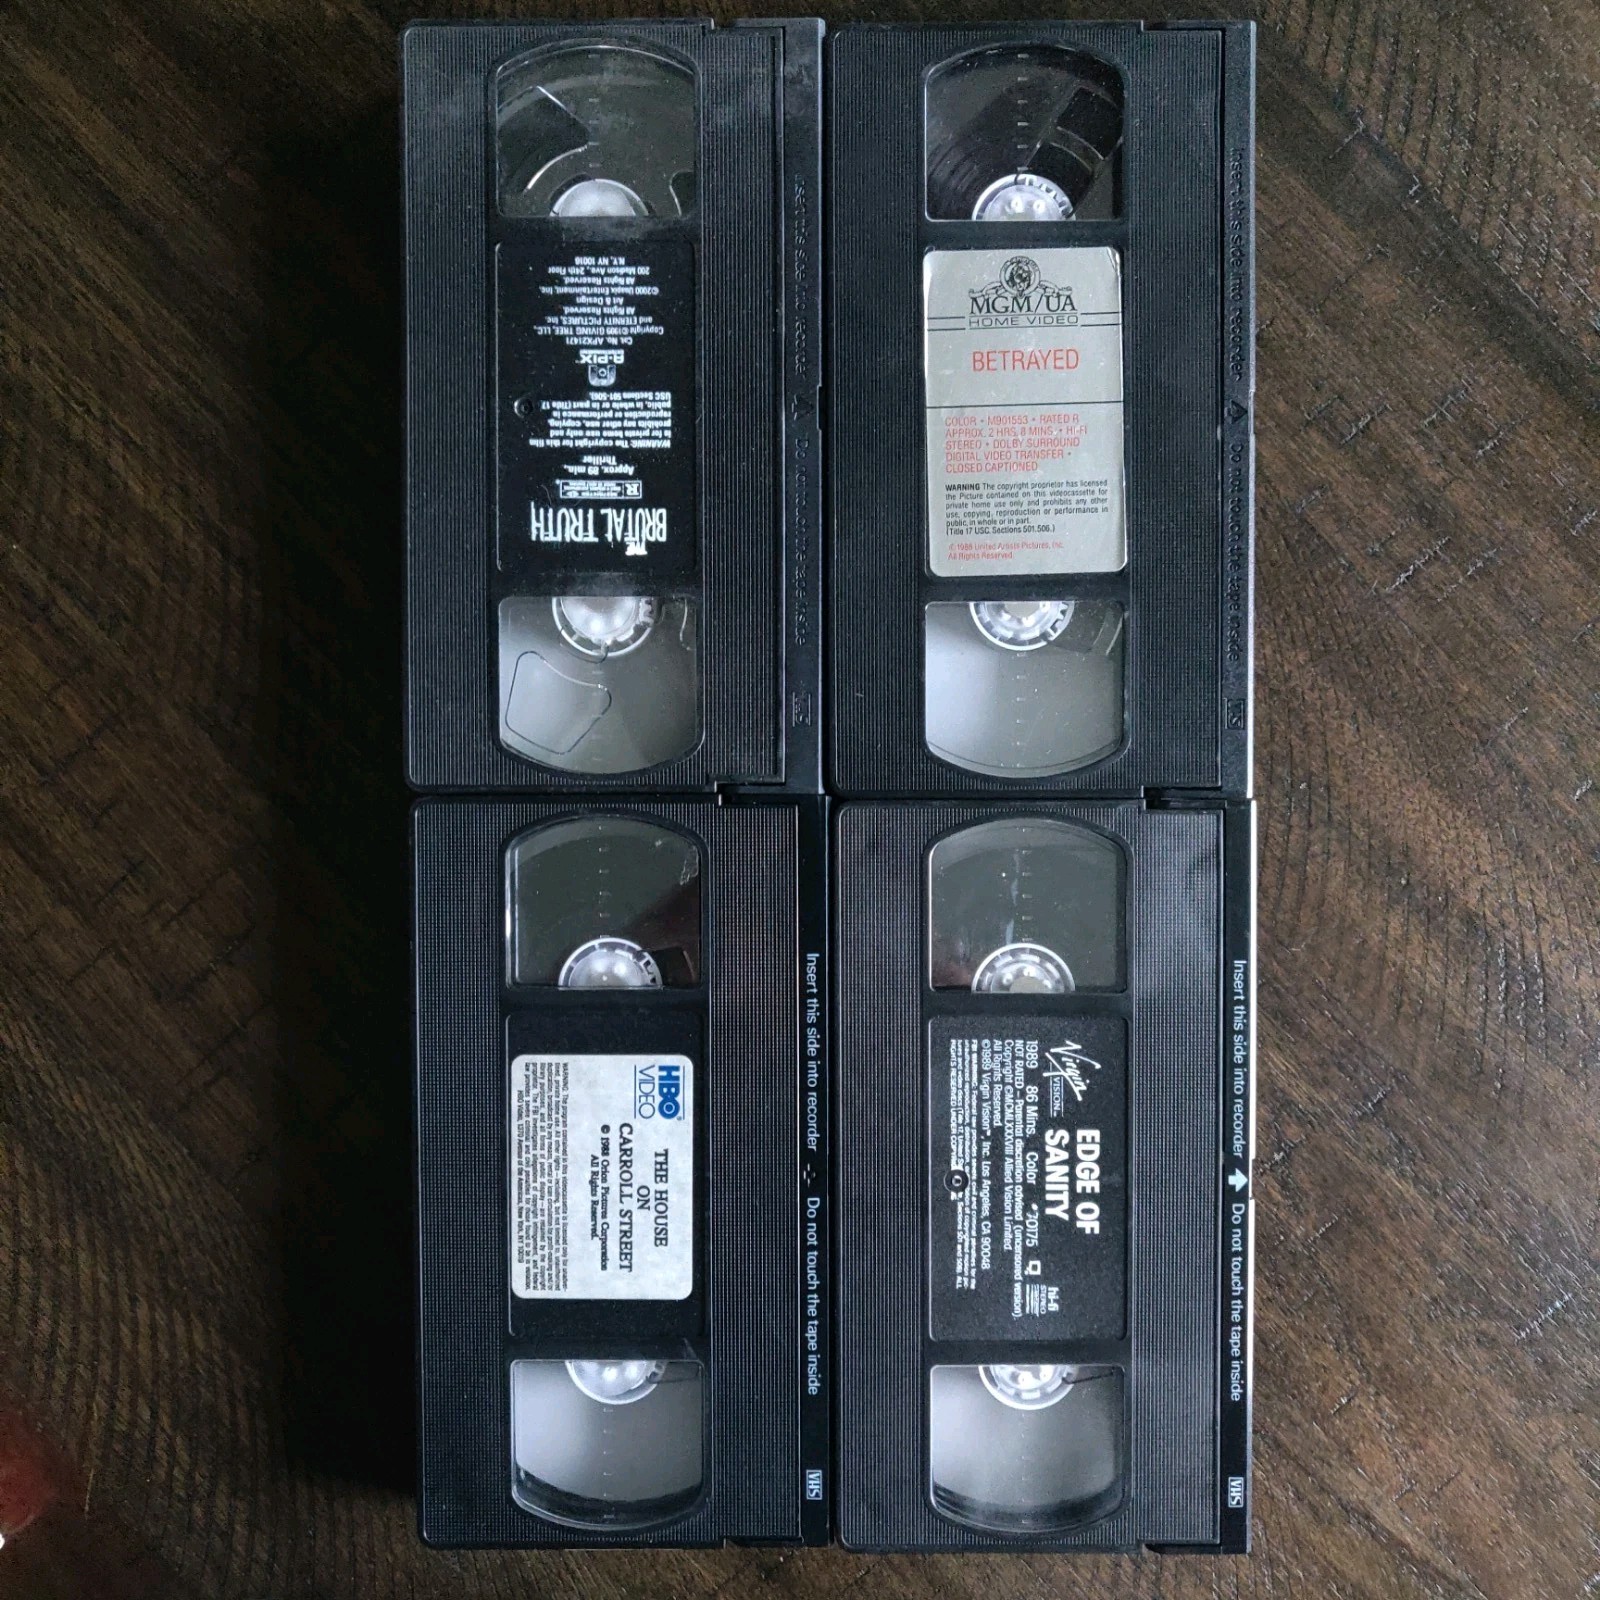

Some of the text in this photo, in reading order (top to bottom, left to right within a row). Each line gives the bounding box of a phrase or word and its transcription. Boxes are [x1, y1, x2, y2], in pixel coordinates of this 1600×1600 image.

[548, 266, 566, 275] Floor
[568, 266, 584, 274] 24th
[598, 256, 608, 265] NY
[608, 266, 636, 274] Madison
[637, 266, 650, 275] 200
[554, 286, 608, 294] Entertainment,
[564, 277, 601, 285] Reserved.
[604, 276, 624, 284] Rights
[635, 286, 659, 294] ©2000
[563, 306, 601, 314] Reserved.
[576, 296, 603, 305] Design
[604, 306, 624, 314] Rights
[613, 297, 623, 305] Art
[969, 294, 1078, 315] MGM/UA
[545, 316, 652, 325] and ETERNITY PICTURES, Inc.
[552, 326, 572, 334] TREE,
[630, 325, 664, 334] Copyright
[969, 315, 1078, 327] HOME VIDEO
[973, 349, 1079, 371] BETRAYED
[945, 413, 1080, 426] COLOR M901553 RATED R
[946, 428, 986, 438] APPROX.
[989, 428, 993, 437] 2
[1021, 427, 1026, 436] 8
[1067, 426, 1087, 434] HI-FI
[946, 438, 1080, 450] STEREO DOLBY SURROUND
[582, 456, 616, 465] Thriller
[946, 449, 1063, 461] DIGITAL VIDEO TRANSFER
[588, 466, 598, 474] 89
[601, 464, 634, 475] Approx.
[946, 462, 1037, 473] CLOSED CAPTIONED
[625, 484, 639, 495] R
[946, 483, 980, 491] WARNING
[997, 482, 1028, 491] copyright
[1080, 480, 1107, 489] licensed
[531, 502, 666, 542] BRUTAL TRUTH
[946, 527, 963, 535] (Title
[625, 542, 648, 556] THE
[806, 954, 820, 1151] Insert this side into recorder
[982, 1039, 991, 1070] ©1989
[1012, 1040, 1024, 1056] NOT
[1026, 1040, 1038, 1068] 1989
[1233, 960, 1246, 1158] Insert this side into recorder
[1003, 1040, 1014, 1082] Copyright
[1042, 1040, 1101, 1102] Virgin
[980, 1073, 991, 1099] Virgin
[992, 1039, 1002, 1128] All Rights Reserved.
[1012, 1061, 1024, 1090] RATED
[638, 1065, 655, 1119] VIDEO
[658, 1064, 680, 1120] HBO
[1026, 1086, 1038, 1102] 86
[1052, 1076, 1062, 1110] VISION
[1012, 1100, 1024, 1137] Parental
[1026, 1106, 1038, 1137] Mins.
[601, 1138, 609, 1156] 1988
[982, 1142, 991, 1158] Inc.
[601, 1159, 609, 1183] Orion
[982, 1161, 991, 1176] Los
[1004, 1157, 1013, 1183] Allied
[1012, 1138, 1024, 1182] discretion
[1026, 1152, 1038, 1185] Color
[1045, 1129, 1069, 1220] SANITY
[1076, 1129, 1100, 1234] EDGE OF
[590, 1154, 600, 1240] All Rights Reserved.
[601, 1187, 609, 1219] Pictures
[619, 1123, 633, 1272] CARROLL STREET
[637, 1185, 650, 1210] ON
[654, 1149, 668, 1247] THE HOUSE
[980, 1180, 991, 1218] Angeles,
[1004, 1186, 1013, 1214] Vision
[1012, 1186, 1024, 1220] advised
[982, 1221, 991, 1234] CA
[1004, 1216, 1012, 1251] Limited.
[599, 1222, 609, 1271] Corporation
[981, 1237, 991, 1270] 90048
[1014, 1226, 1023, 1280] (uncensored
[805, 1198, 821, 1395] Do not touch the tape inside
[1048, 1287, 1059, 1311] hi-fi
[1229, 1204, 1244, 1401] Do not touch the tape inside
[808, 1472, 821, 1499] VHS
[1230, 1479, 1242, 1506] VHS
